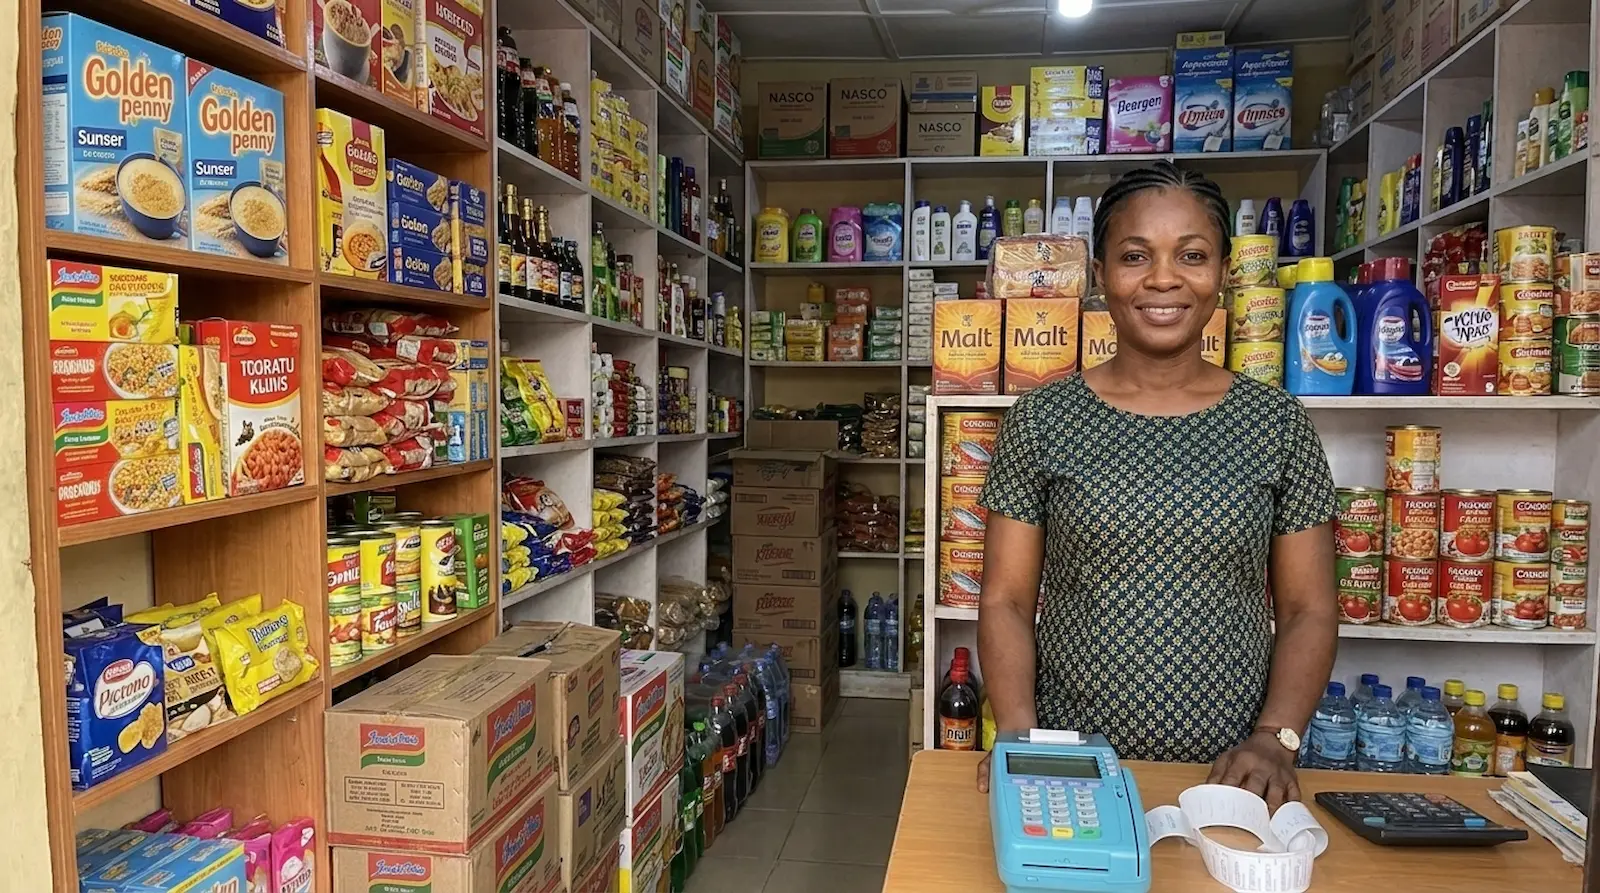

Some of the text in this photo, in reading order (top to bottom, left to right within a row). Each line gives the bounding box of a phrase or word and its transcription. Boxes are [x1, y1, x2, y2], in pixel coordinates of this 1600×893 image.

[85, 58, 173, 101] Golden
[770, 92, 815, 103] NASCO
[841, 88, 887, 100] NASCO
[121, 100, 172, 123] penny
[201, 98, 275, 133] Golden
[919, 122, 962, 133] NASCO
[78, 130, 124, 147] Sunser
[232, 133, 275, 155] penny
[196, 162, 235, 176] Sunser
[941, 327, 993, 348] Malt
[1013, 325, 1068, 347] Malt
[1201, 335, 1220, 354] lt
